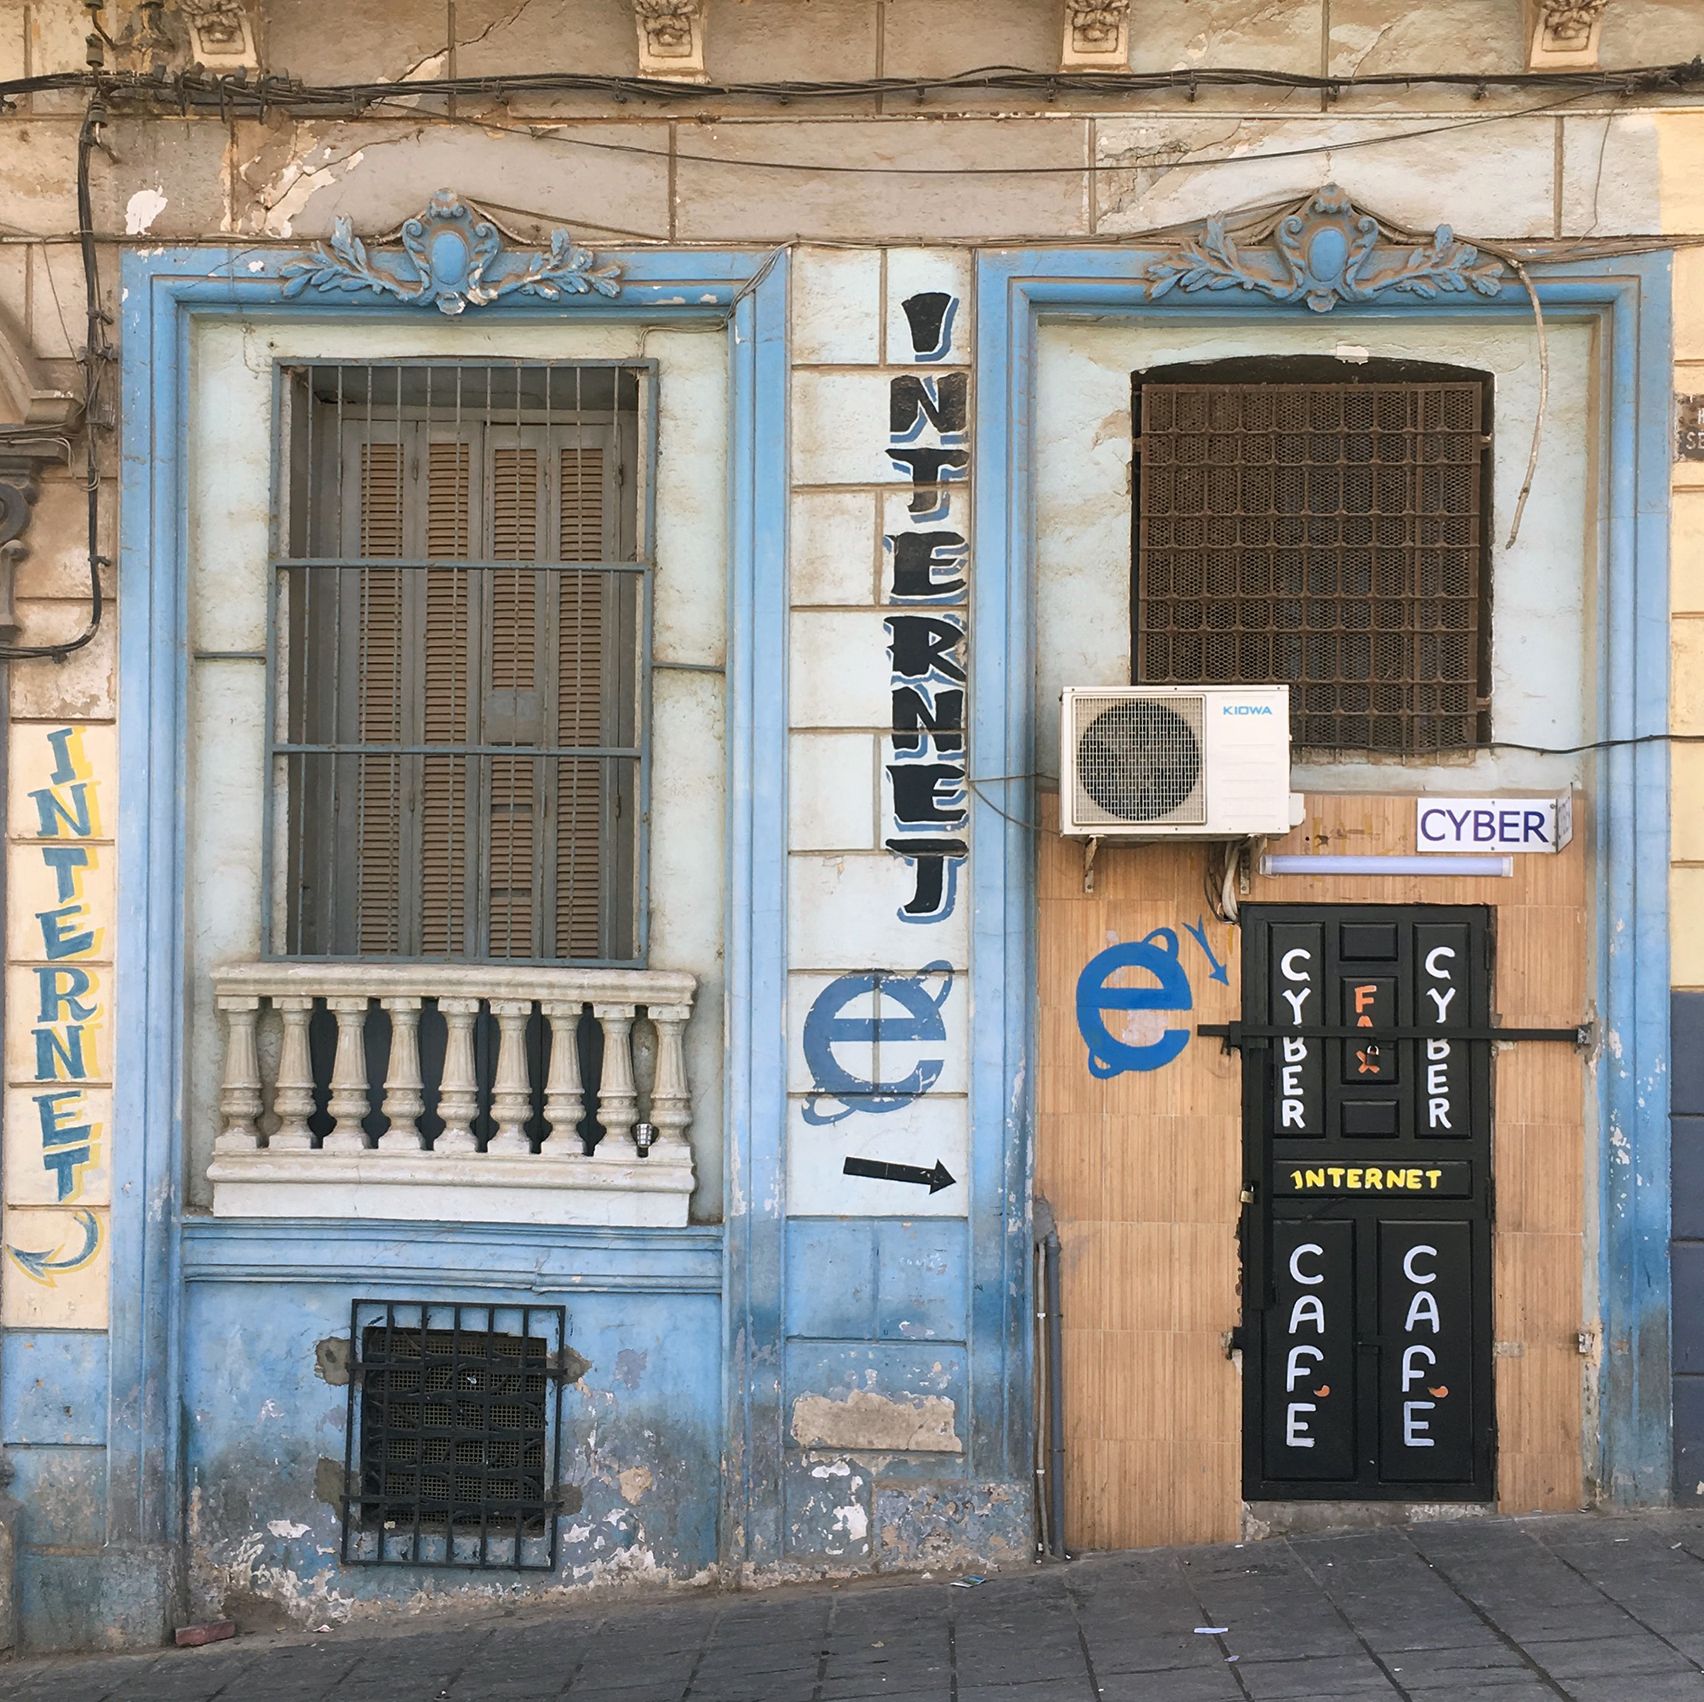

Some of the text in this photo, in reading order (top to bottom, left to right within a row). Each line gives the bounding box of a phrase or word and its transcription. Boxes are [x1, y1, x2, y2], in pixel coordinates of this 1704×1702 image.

[884, 292, 970, 924] INTERNET
[1223, 706, 1272, 715] KIOWA
[1421, 809, 1549, 843] CYBER
[27, 726, 104, 1202] INTERNET
[1281, 948, 1312, 1128] CYBER
[1425, 947, 1456, 1129] CYBER
[1290, 1168, 1442, 1190] INTERNET
